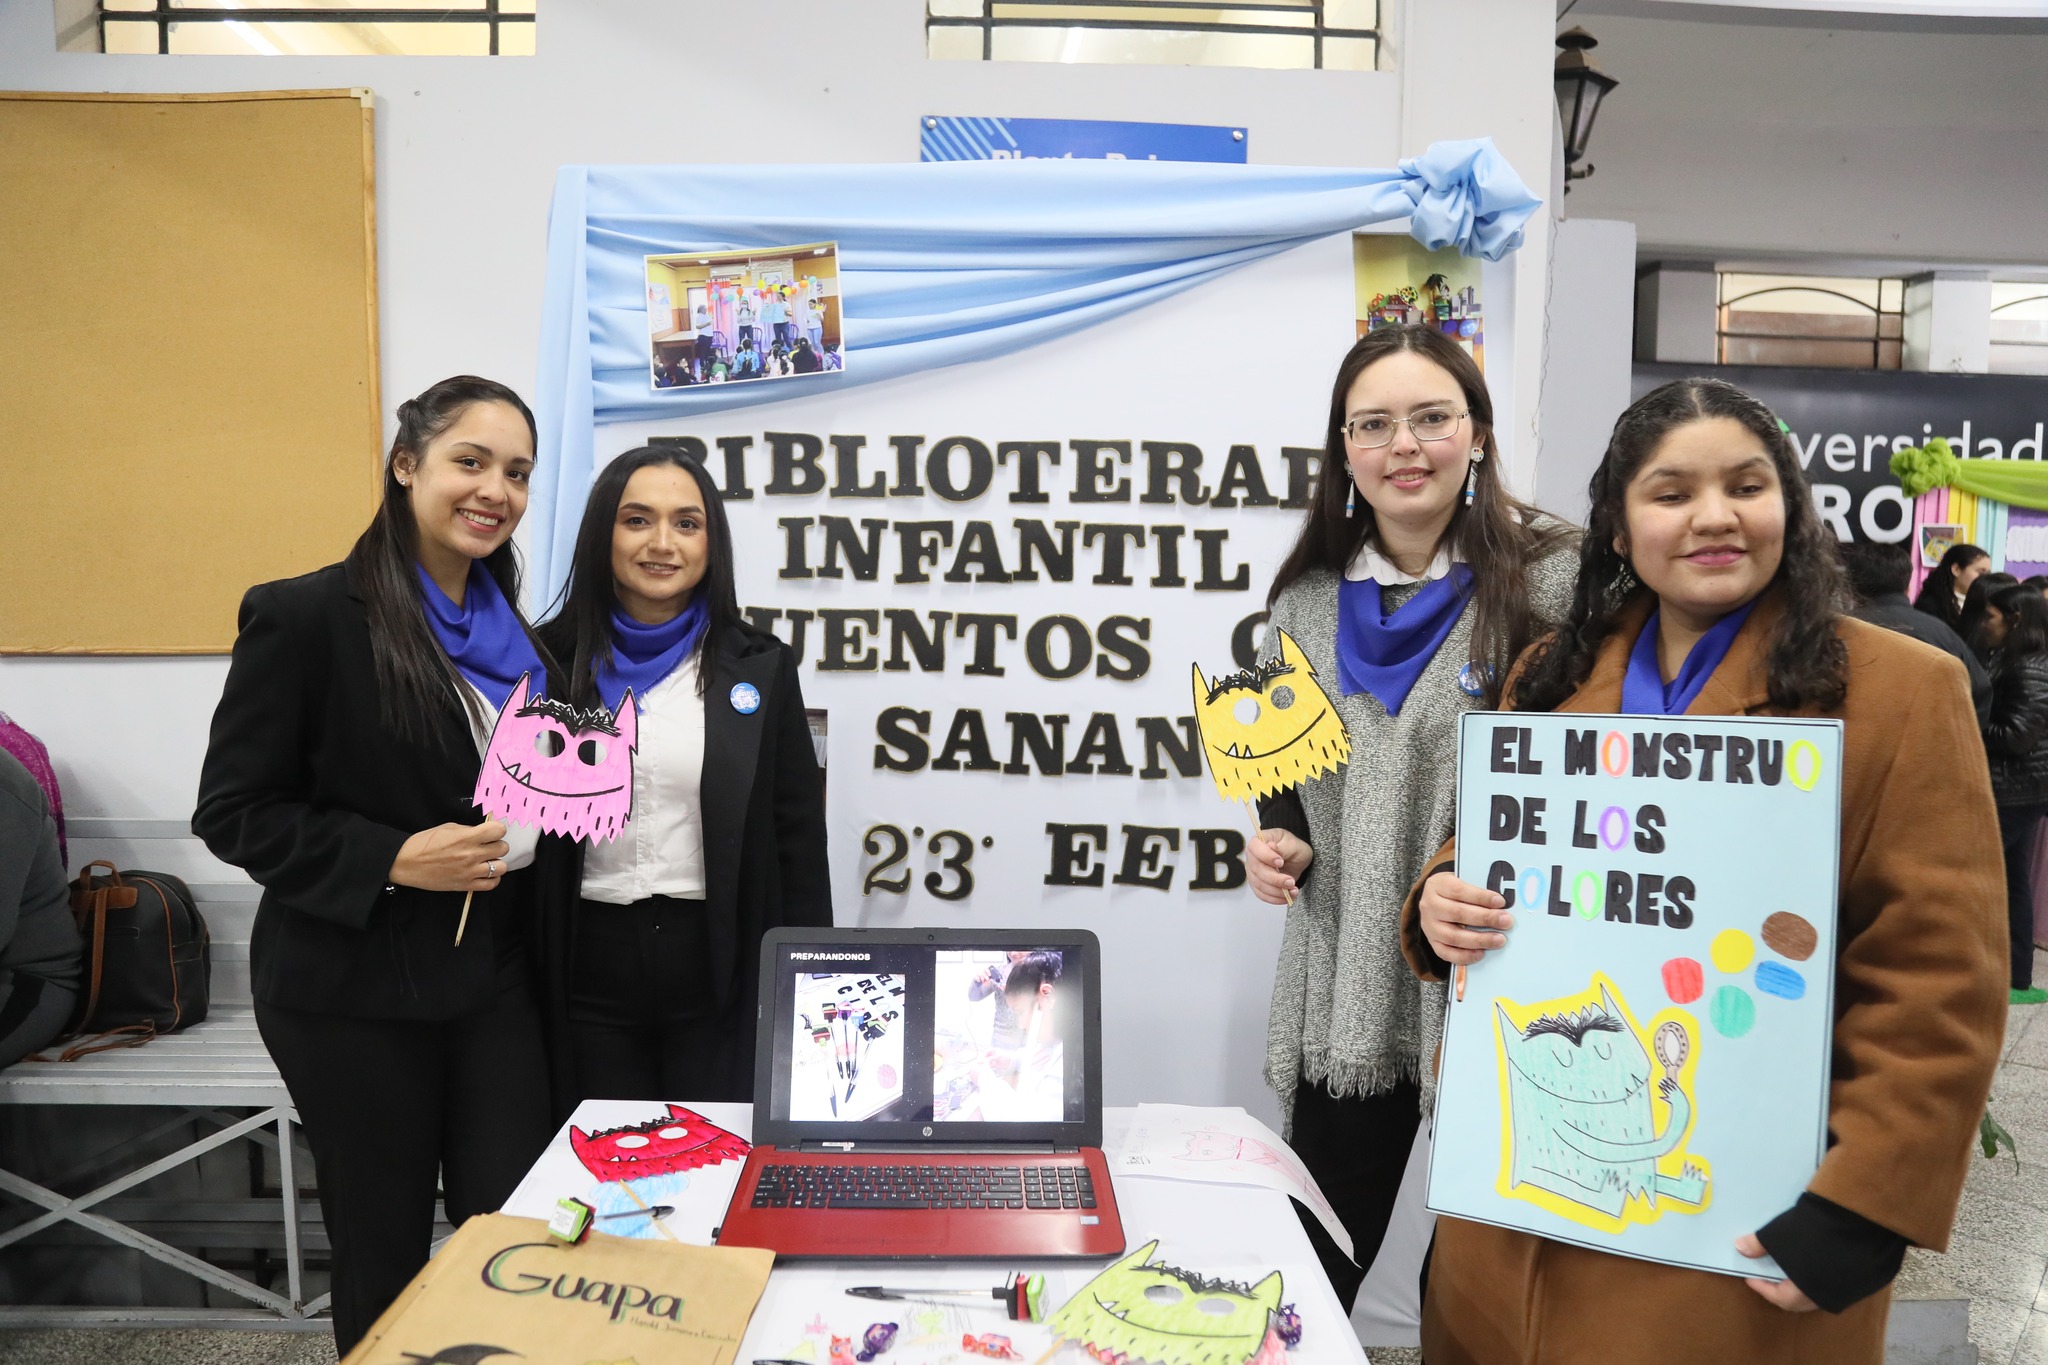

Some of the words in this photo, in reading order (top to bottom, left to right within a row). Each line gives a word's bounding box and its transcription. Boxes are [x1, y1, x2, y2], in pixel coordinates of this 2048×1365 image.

[777, 514, 1250, 592] INFANTIL
[738, 605, 1152, 682] UENTOS
[874, 706, 1203, 780] SANAN
[1490, 726, 1543, 775] EL
[1564, 729, 1822, 791] MONSTRUO
[1044, 822, 1248, 892] EEB
[1489, 795, 1547, 845] DE
[1572, 800, 1667, 854] LOS
[1486, 860, 1697, 929] COLORES
[790, 952, 871, 961] PREPARANDONOS
[480, 1242, 685, 1325] Guapa
